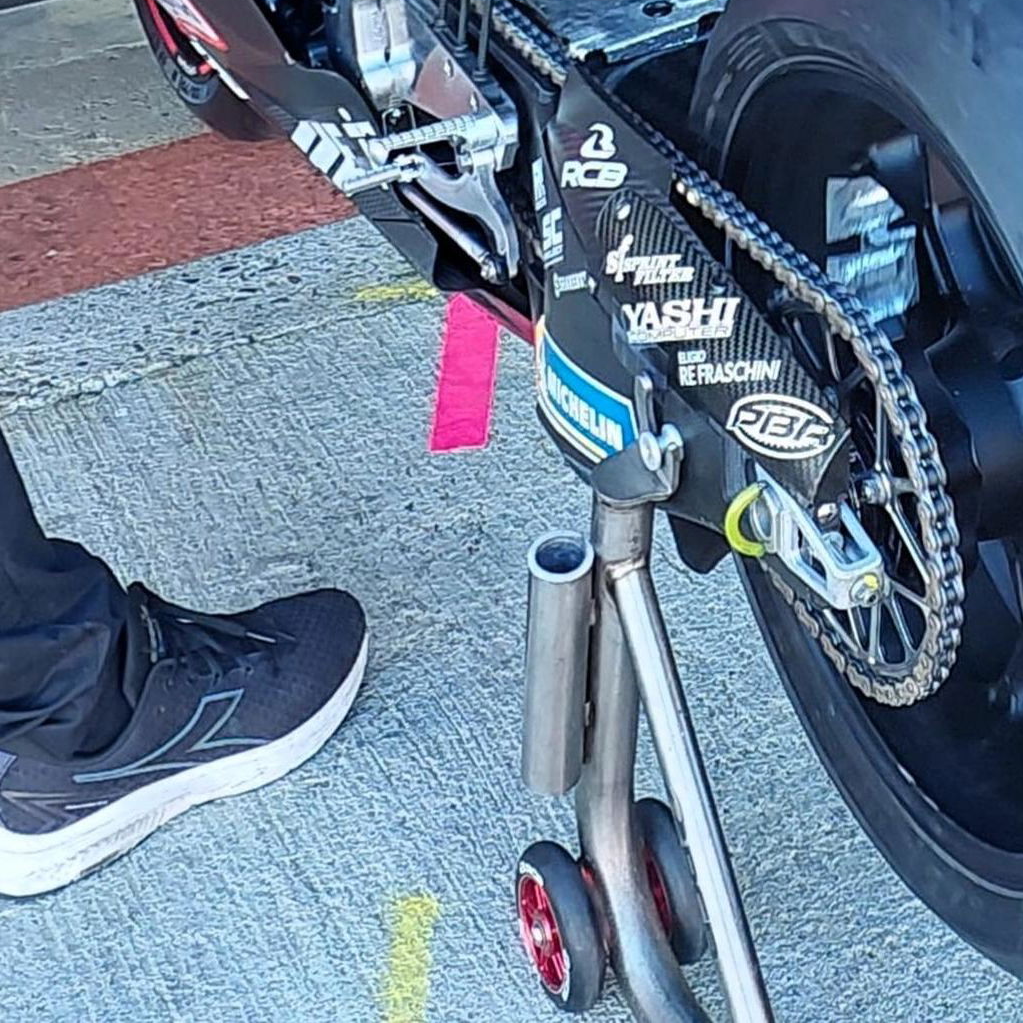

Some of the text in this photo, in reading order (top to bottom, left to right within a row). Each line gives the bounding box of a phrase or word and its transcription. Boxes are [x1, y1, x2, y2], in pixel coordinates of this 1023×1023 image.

[561, 160, 628, 189] RCB
[621, 297, 741, 331] YASHI
[546, 364, 625, 452] MICHELIN
